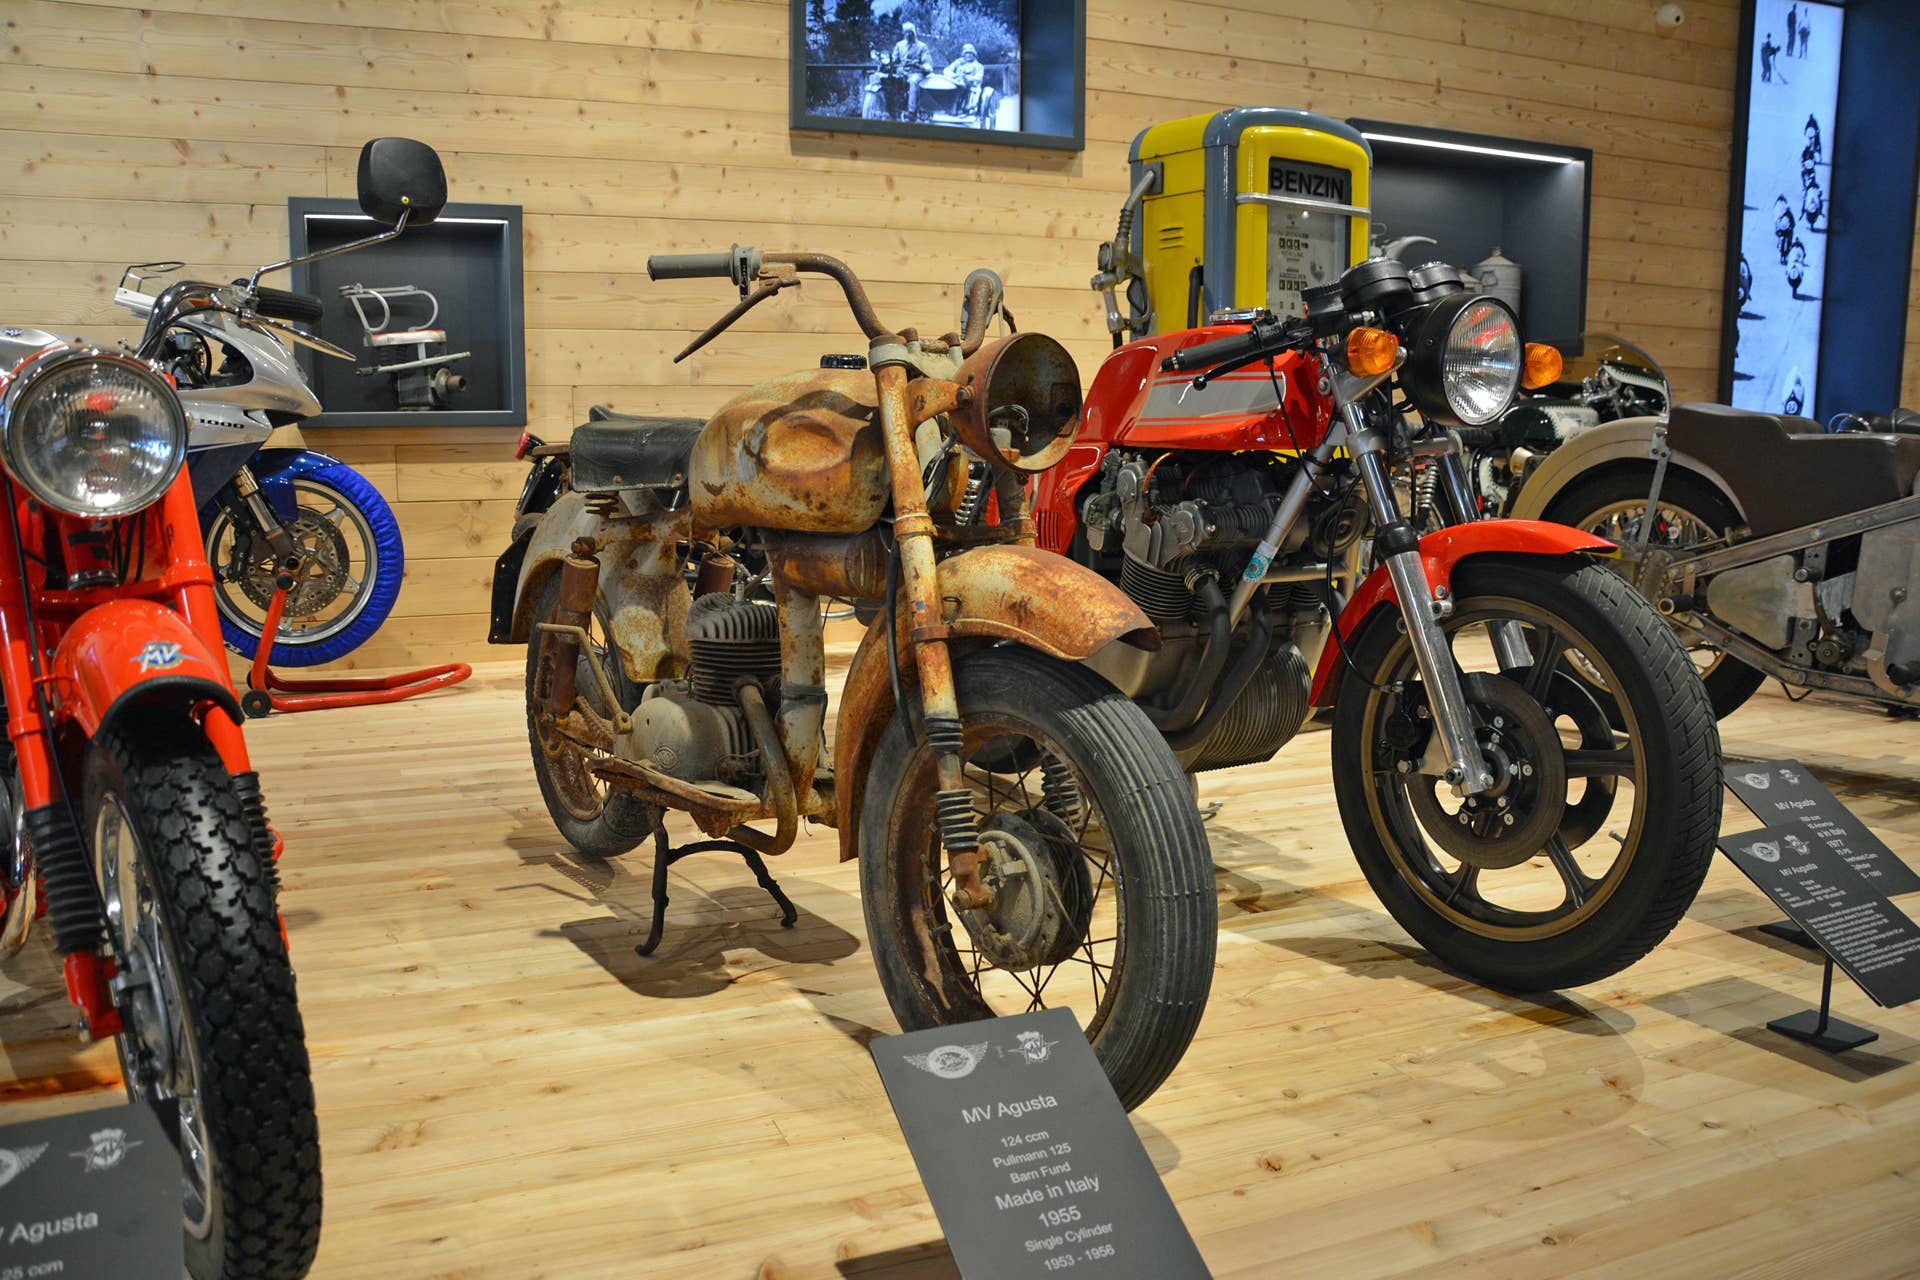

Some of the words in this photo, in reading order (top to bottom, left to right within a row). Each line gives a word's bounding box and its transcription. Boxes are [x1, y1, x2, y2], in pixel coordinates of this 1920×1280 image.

[1270, 167, 1344, 199] BENZIN
[200, 418, 245, 429] 1000
[140, 643, 182, 674] MV
[961, 1104, 991, 1124] MV
[998, 1095, 1058, 1118] Agusta
[1001, 1134, 1023, 1148] 124
[1025, 1131, 1049, 1143] ccm
[992, 1149, 1048, 1168] Pullmann
[1049, 1142, 1071, 1156] 125
[1009, 1170, 1040, 1184] Barn
[1040, 1161, 1071, 1177] Fund
[994, 1188, 1044, 1210] Made
[1045, 1184, 1064, 1199] in
[1065, 1176, 1100, 1192] Italy
[9, 1211, 99, 1244] Agusta
[1039, 1205, 1081, 1228] 1955
[1025, 1235, 1064, 1252] Single
[1065, 1223, 1113, 1243] Cylinder
[28, 1259, 64, 1278] ccm
[1044, 1254, 1075, 1271] 1953
